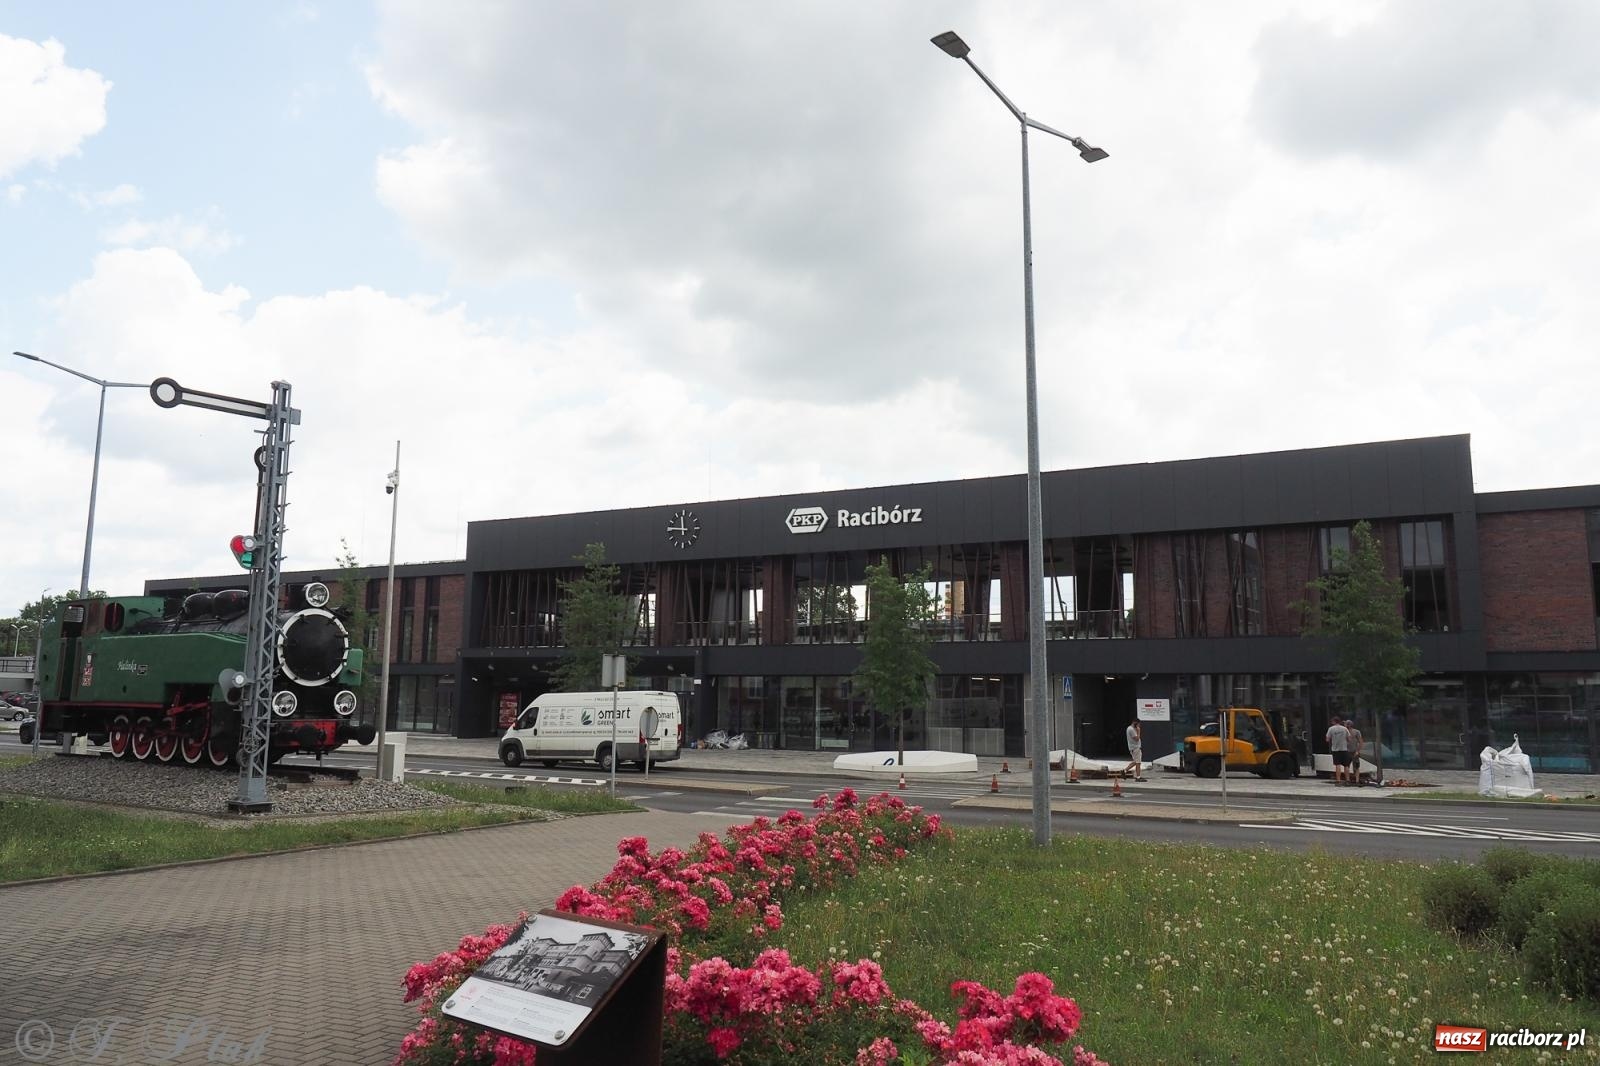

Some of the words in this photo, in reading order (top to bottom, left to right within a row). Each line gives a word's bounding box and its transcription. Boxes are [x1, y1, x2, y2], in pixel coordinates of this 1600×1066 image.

[792, 513, 822, 527] PKP
[837, 504, 922, 528] Racibórz
[598, 707, 631, 719] smart
